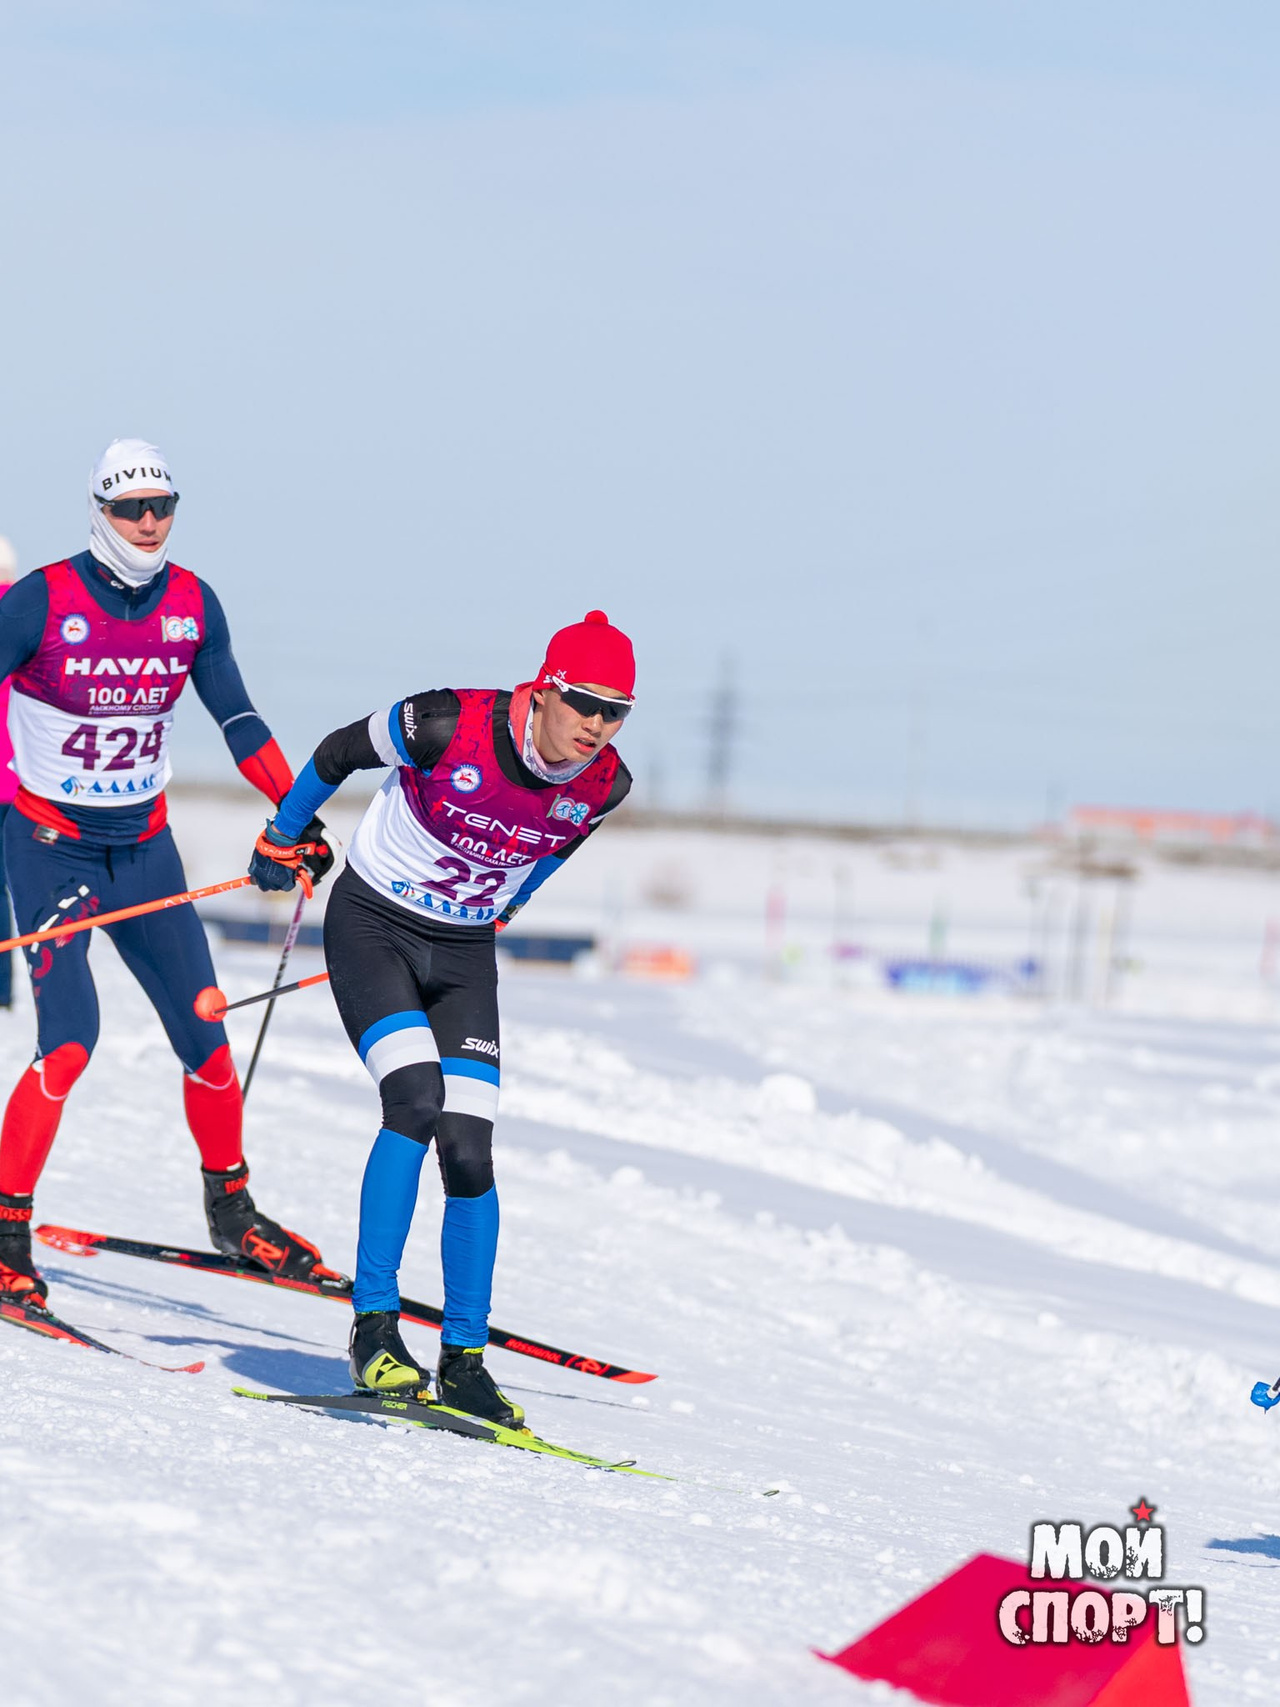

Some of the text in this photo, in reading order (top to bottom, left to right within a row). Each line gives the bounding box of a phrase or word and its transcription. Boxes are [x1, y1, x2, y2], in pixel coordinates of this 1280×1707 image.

[65, 657, 188, 675] HAVAL
[87, 687, 169, 705] 100 ЛЕТ
[61, 721, 165, 771] 424
[442, 801, 566, 848] TENET
[450, 832, 532, 865] 100 ЛЕТ
[418, 856, 508, 907] 22
[381, 1400, 408, 1411] FISCHER
